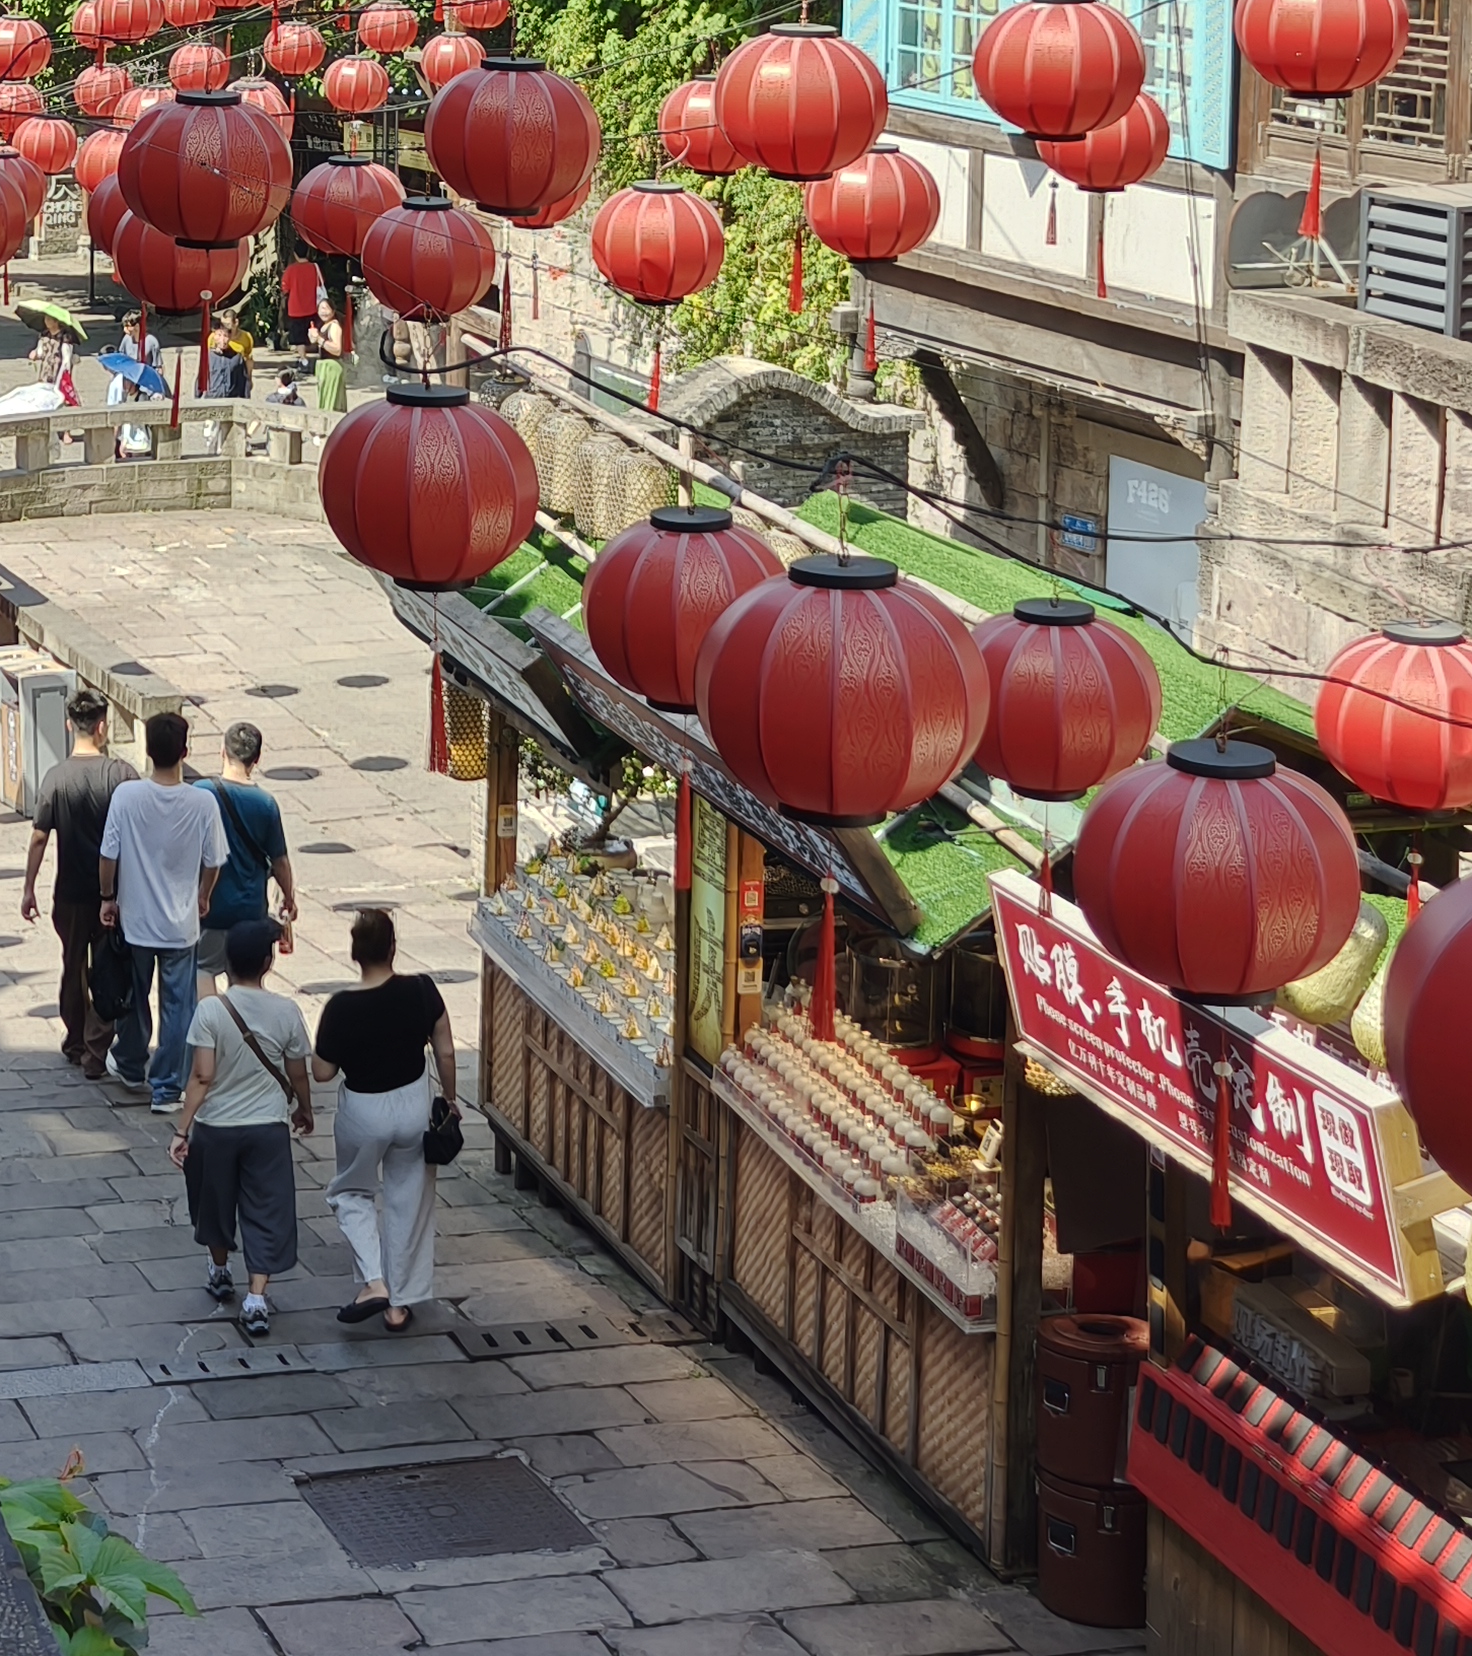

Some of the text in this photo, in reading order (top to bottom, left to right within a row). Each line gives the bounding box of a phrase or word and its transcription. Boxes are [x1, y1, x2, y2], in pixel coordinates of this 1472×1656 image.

[43, 201, 83, 213] CHONG
[43, 212, 76, 225] QING
[1126, 479, 1170, 514] F426
[1035, 992, 1067, 1029] Phone
[1067, 1019, 1104, 1052] screen
[1103, 1041, 1156, 1084] protector
